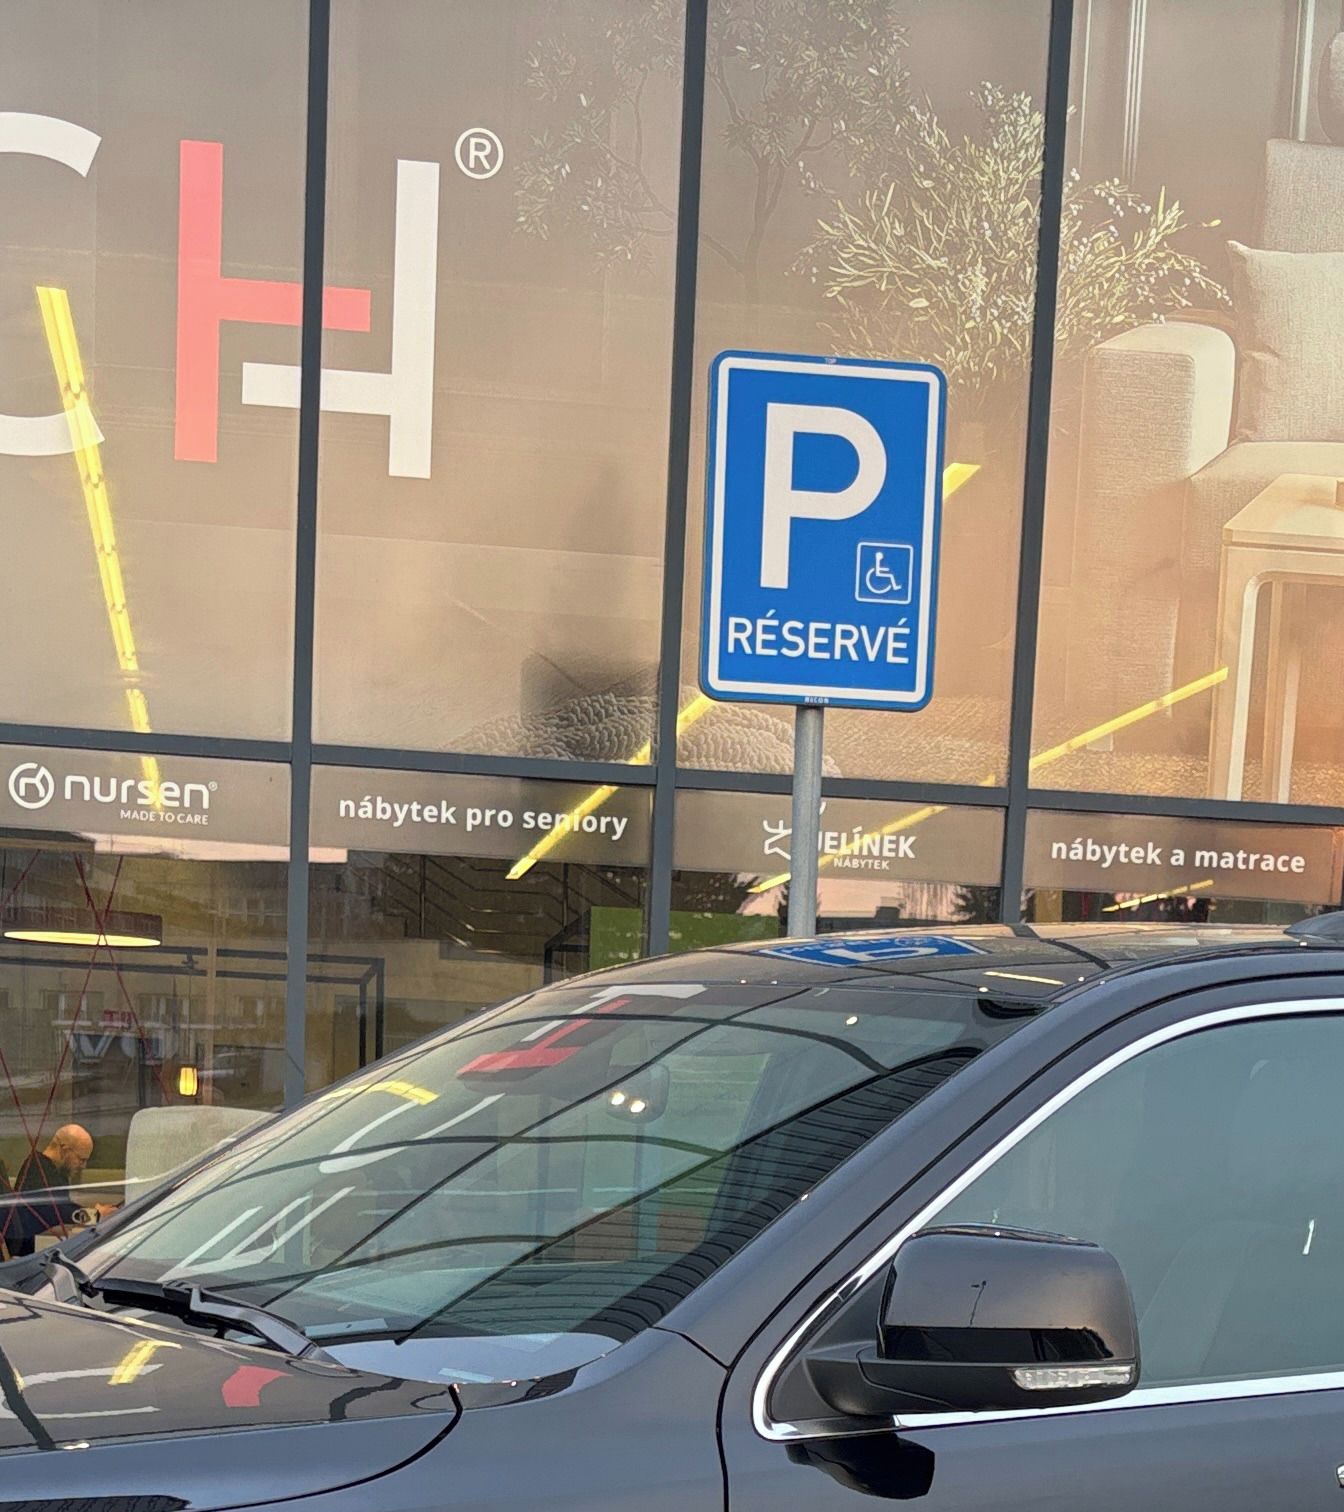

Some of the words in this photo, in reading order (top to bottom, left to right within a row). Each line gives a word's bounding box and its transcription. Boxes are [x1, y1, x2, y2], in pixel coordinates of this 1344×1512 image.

[760, 402, 887, 589] P
[727, 609, 911, 664] RÉSERVÉ
[120, 809, 156, 821] MADE
[158, 812, 176, 823] TO
[177, 813, 210, 825] CARE
[340, 795, 456, 827] nábytek
[466, 806, 514, 831] pro
[523, 811, 628, 839] seniory
[833, 857, 890, 870] NÁBYTEK
[1052, 837, 1162, 868] nábytek
[1171, 848, 1185, 866] a
[1195, 849, 1306, 873] matrace
